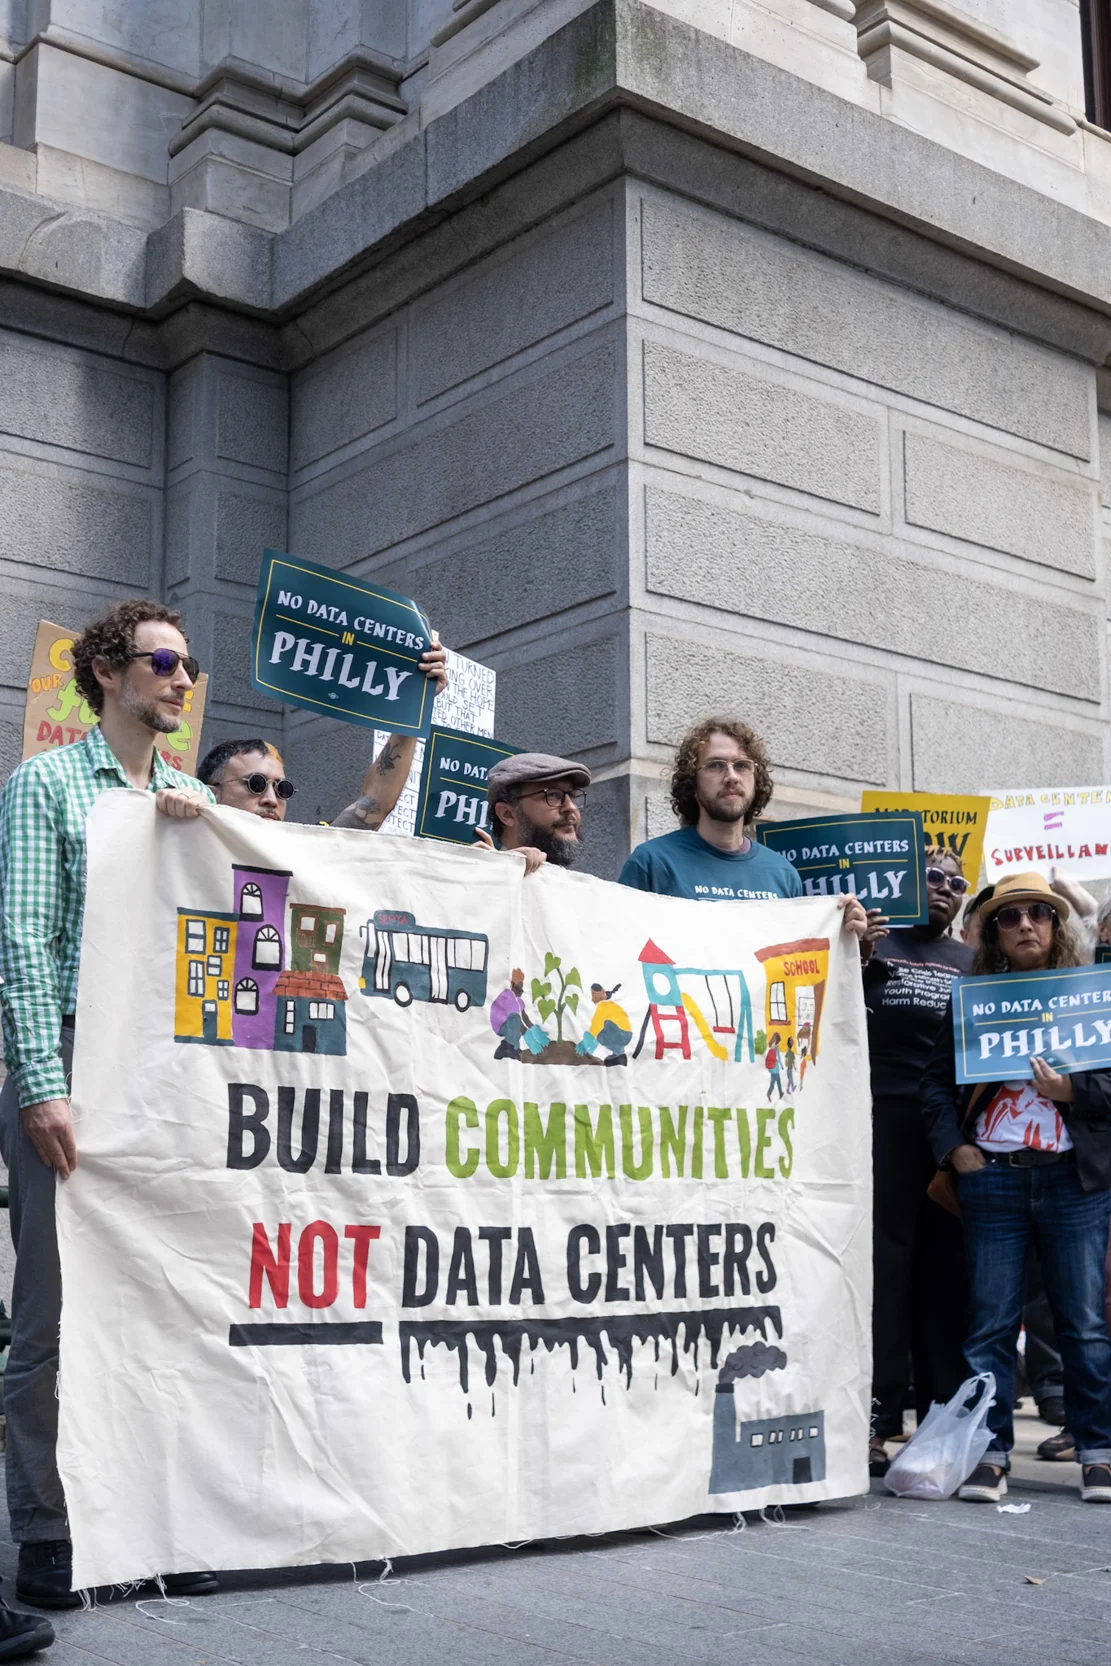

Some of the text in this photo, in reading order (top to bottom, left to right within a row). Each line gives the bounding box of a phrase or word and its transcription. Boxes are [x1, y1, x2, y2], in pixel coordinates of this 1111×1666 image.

[277, 590, 425, 650] NO DATA CENTERS
[341, 631, 355, 646] IN
[268, 631, 413, 701] PHILLY
[453, 654, 495, 684] TURNED
[31, 673, 63, 693] OUR
[469, 678, 495, 698] OVER
[470, 692, 495, 712] HOPE
[455, 706, 477, 723] THAT
[440, 757, 489, 780] NO DAT
[434, 790, 490, 829] PHI
[990, 794, 1035, 811] DATA
[801, 844, 840, 860] DATA
[844, 840, 909, 855] CENTERS
[990, 843, 1109, 866] SURVEILLAN
[838, 858, 850, 869] IN
[694, 885, 779, 899] NO DATA CENTERS
[802, 870, 907, 900] HILLY
[377, 913, 409, 925] SEPTA
[783, 959, 820, 977] SCHOOL
[884, 987, 912, 995] Youth
[882, 997, 948, 1009] Harm Reduc
[972, 989, 1111, 1017] NO DATA CENTER
[1041, 1011, 1054, 1023] IN
[978, 1018, 1111, 1060] PHILLY
[226, 1082, 796, 1180] BUILD COMMUNITIES
[249, 1219, 776, 1310] NOT DATA CENTERS
